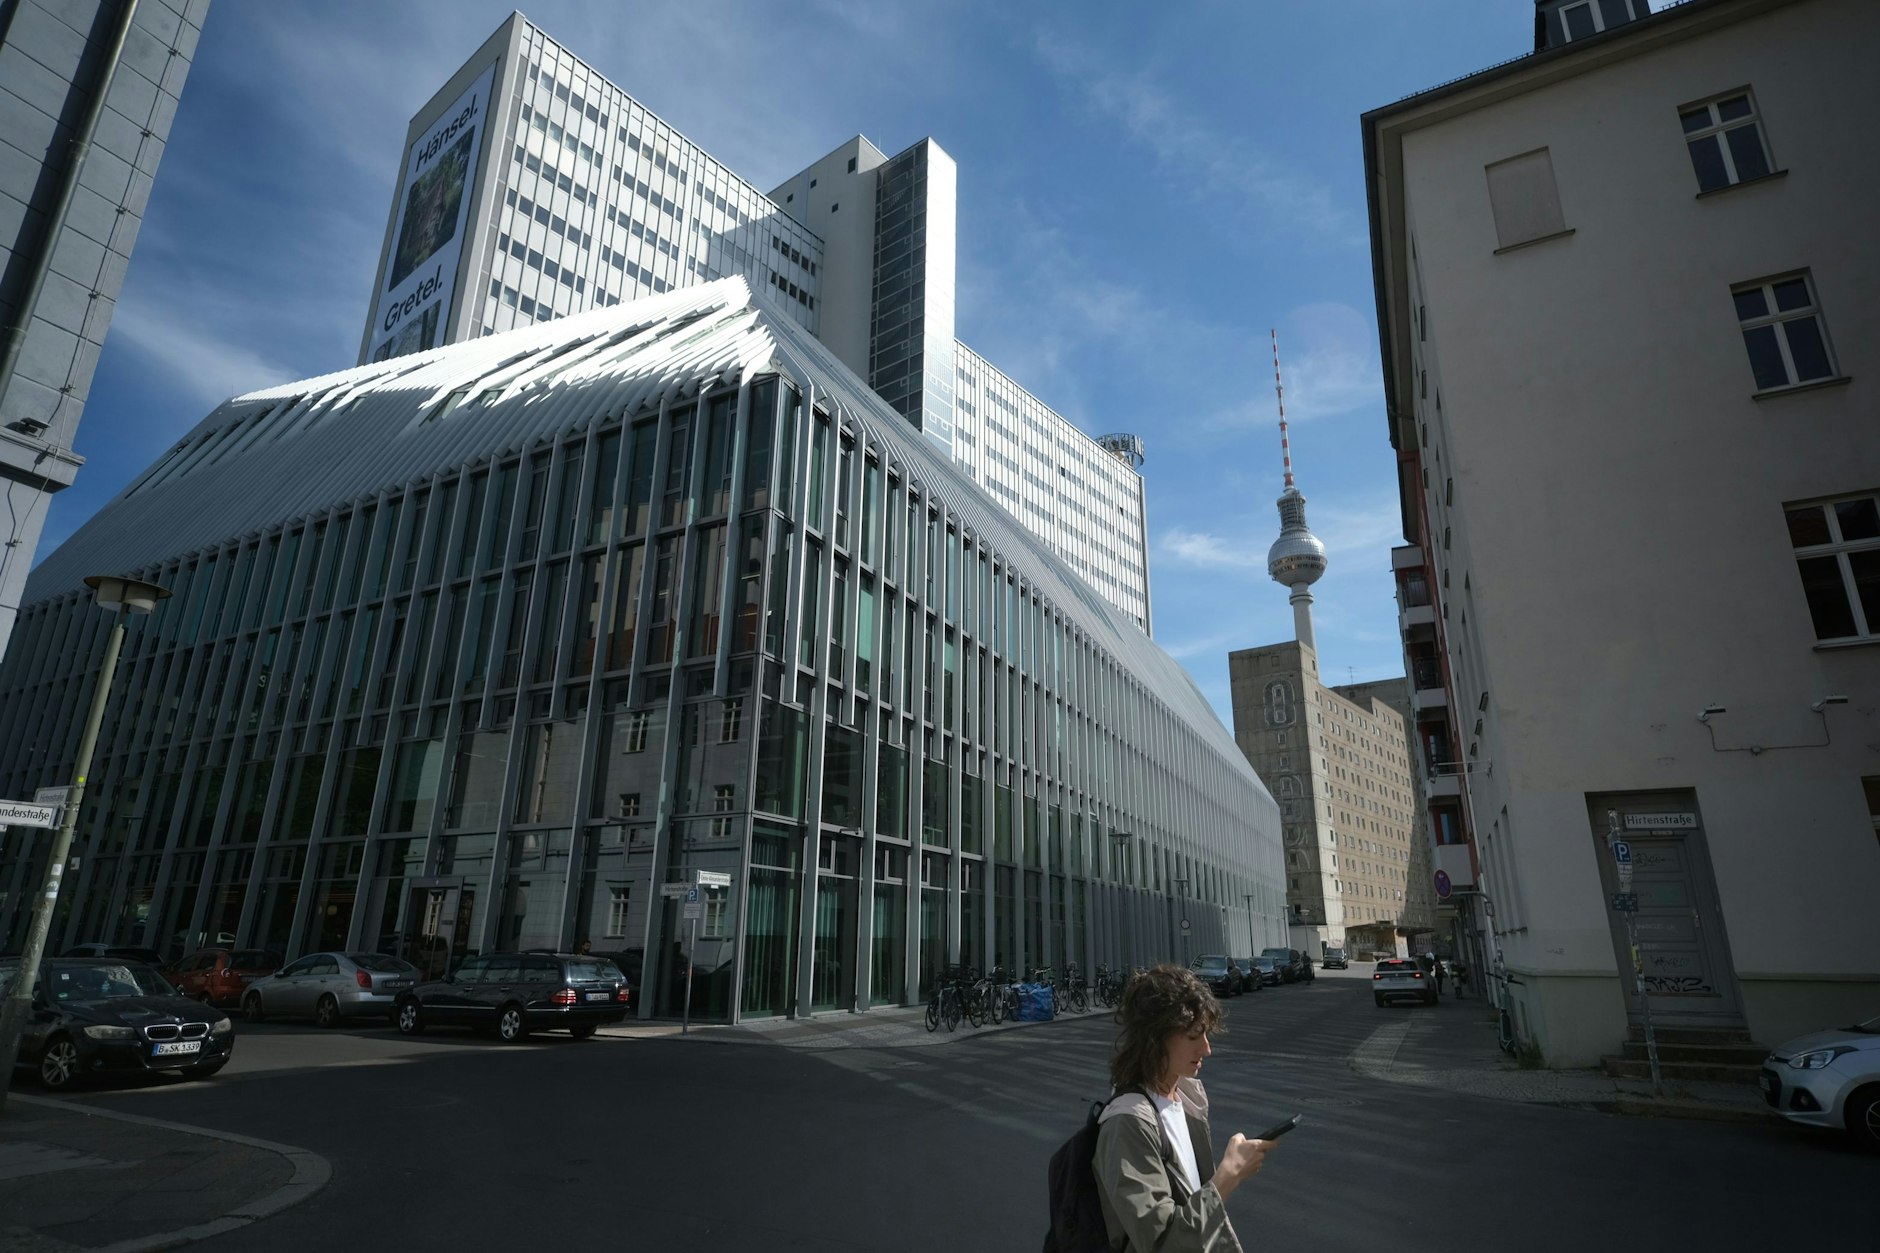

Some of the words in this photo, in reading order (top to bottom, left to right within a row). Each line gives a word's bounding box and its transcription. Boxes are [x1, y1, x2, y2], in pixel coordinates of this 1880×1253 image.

[415, 93, 478, 173] Hänsel.
[384, 264, 443, 332] Gretel.
[1626, 814, 1692, 826] Hirtenstraße
[159, 1045, 165, 1053] B
[170, 1044, 180, 1053] SK
